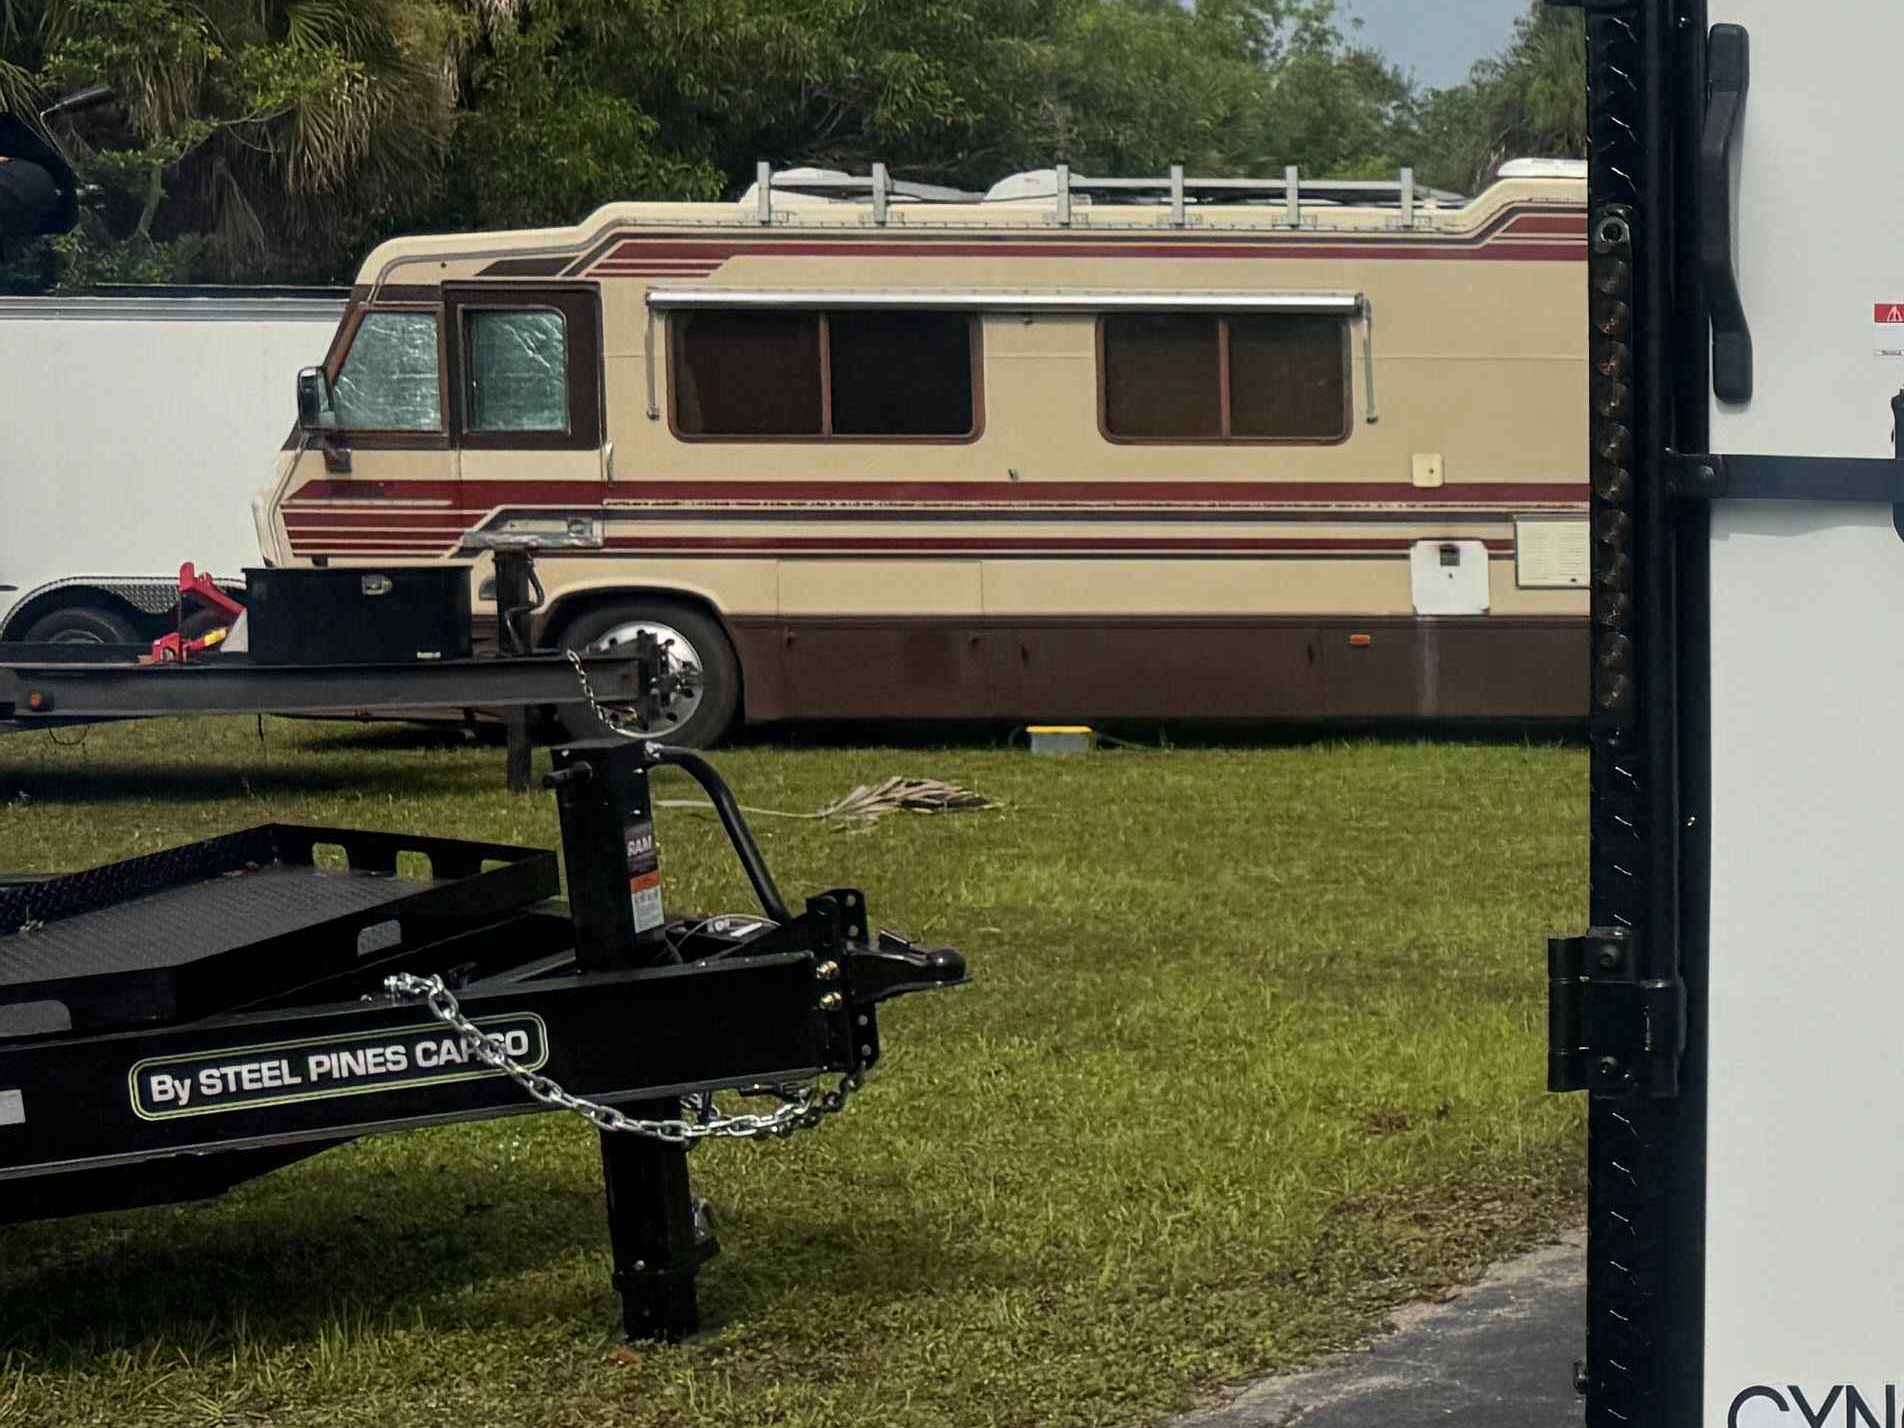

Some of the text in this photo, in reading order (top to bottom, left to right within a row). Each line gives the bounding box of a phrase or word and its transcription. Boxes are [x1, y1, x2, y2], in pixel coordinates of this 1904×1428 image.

[150, 1074, 191, 1106] By
[199, 1059, 302, 1096] STEEL
[308, 1045, 408, 1082] PINES
